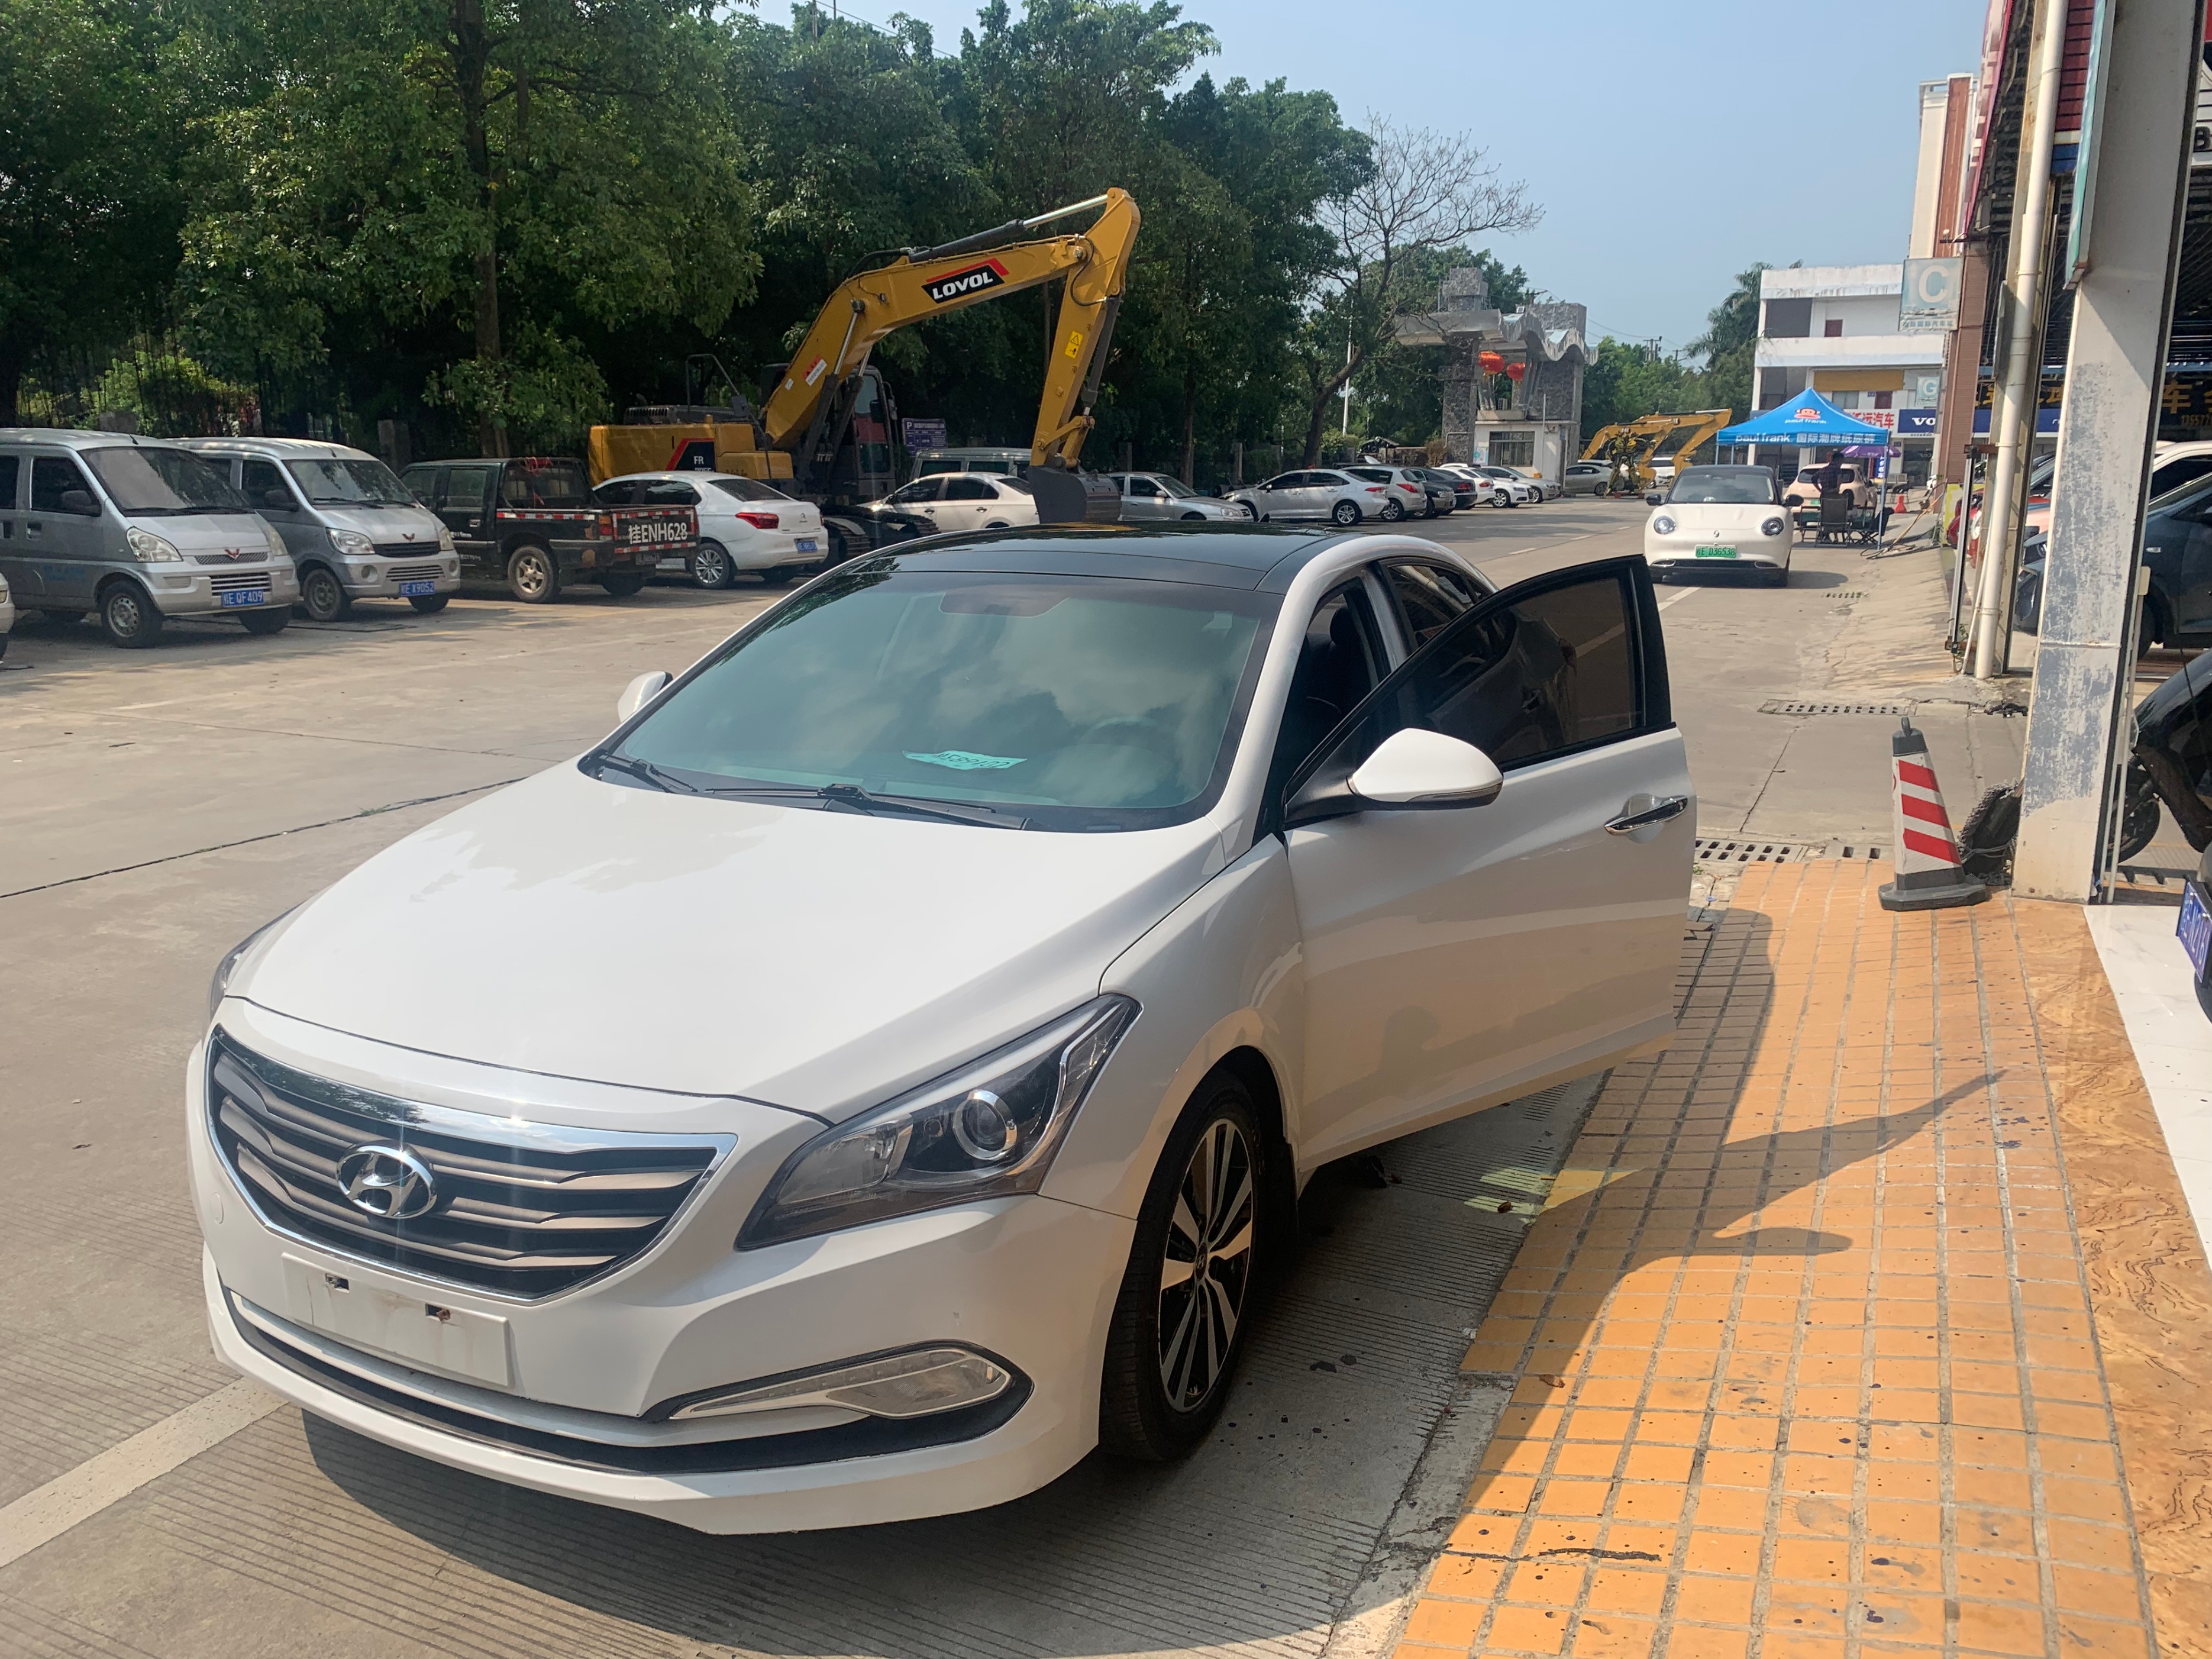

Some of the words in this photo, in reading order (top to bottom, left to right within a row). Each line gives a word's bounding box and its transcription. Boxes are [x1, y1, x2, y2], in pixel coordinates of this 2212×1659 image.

[932, 272, 993, 300] LOVOL
[1919, 265, 1949, 303] C
[1923, 379, 1937, 396] G
[1736, 432, 1759, 443] paul
[1762, 432, 1790, 443] frank
[694, 456, 704, 464] FR
[628, 522, 687, 544] 桂ENH628
